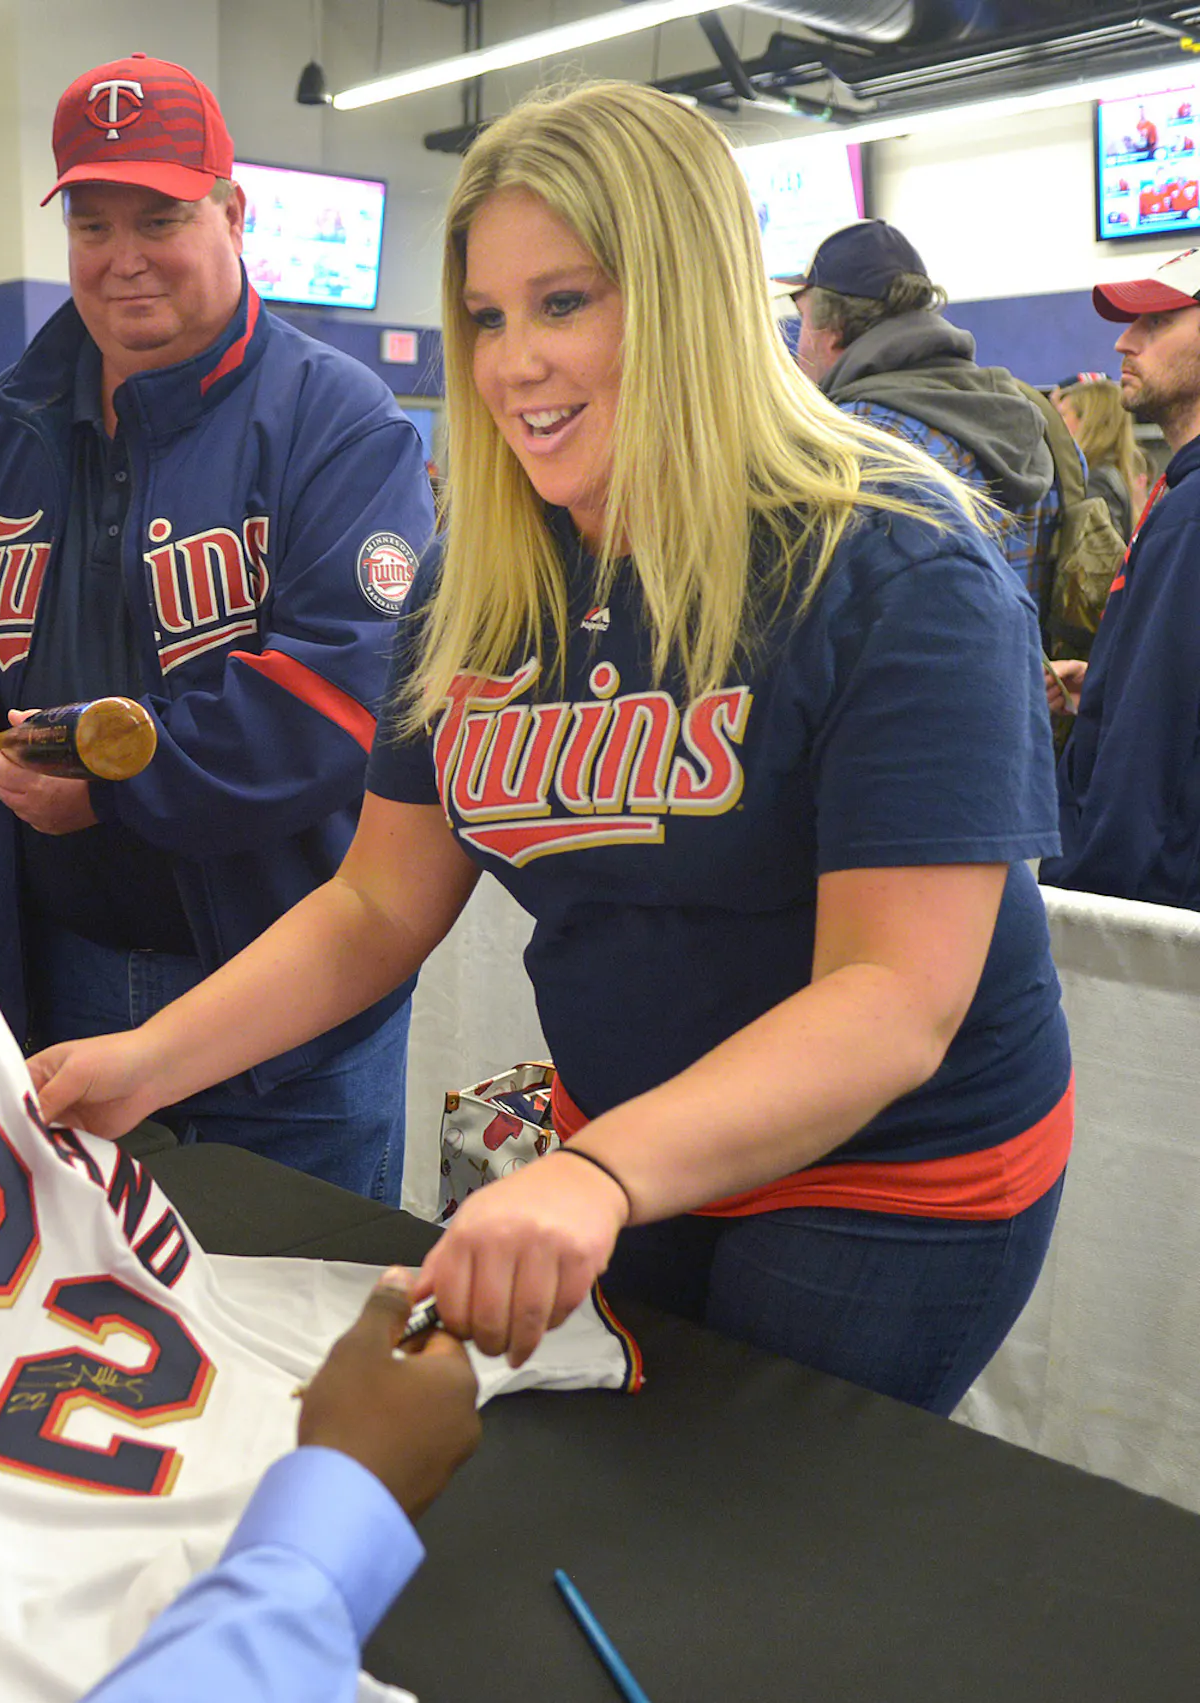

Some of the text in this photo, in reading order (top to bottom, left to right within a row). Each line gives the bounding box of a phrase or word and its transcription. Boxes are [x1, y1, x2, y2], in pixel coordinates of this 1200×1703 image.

[366, 536, 414, 564] MINNESOTA
[362, 557, 416, 586] Twins
[426, 655, 754, 829] Twins
